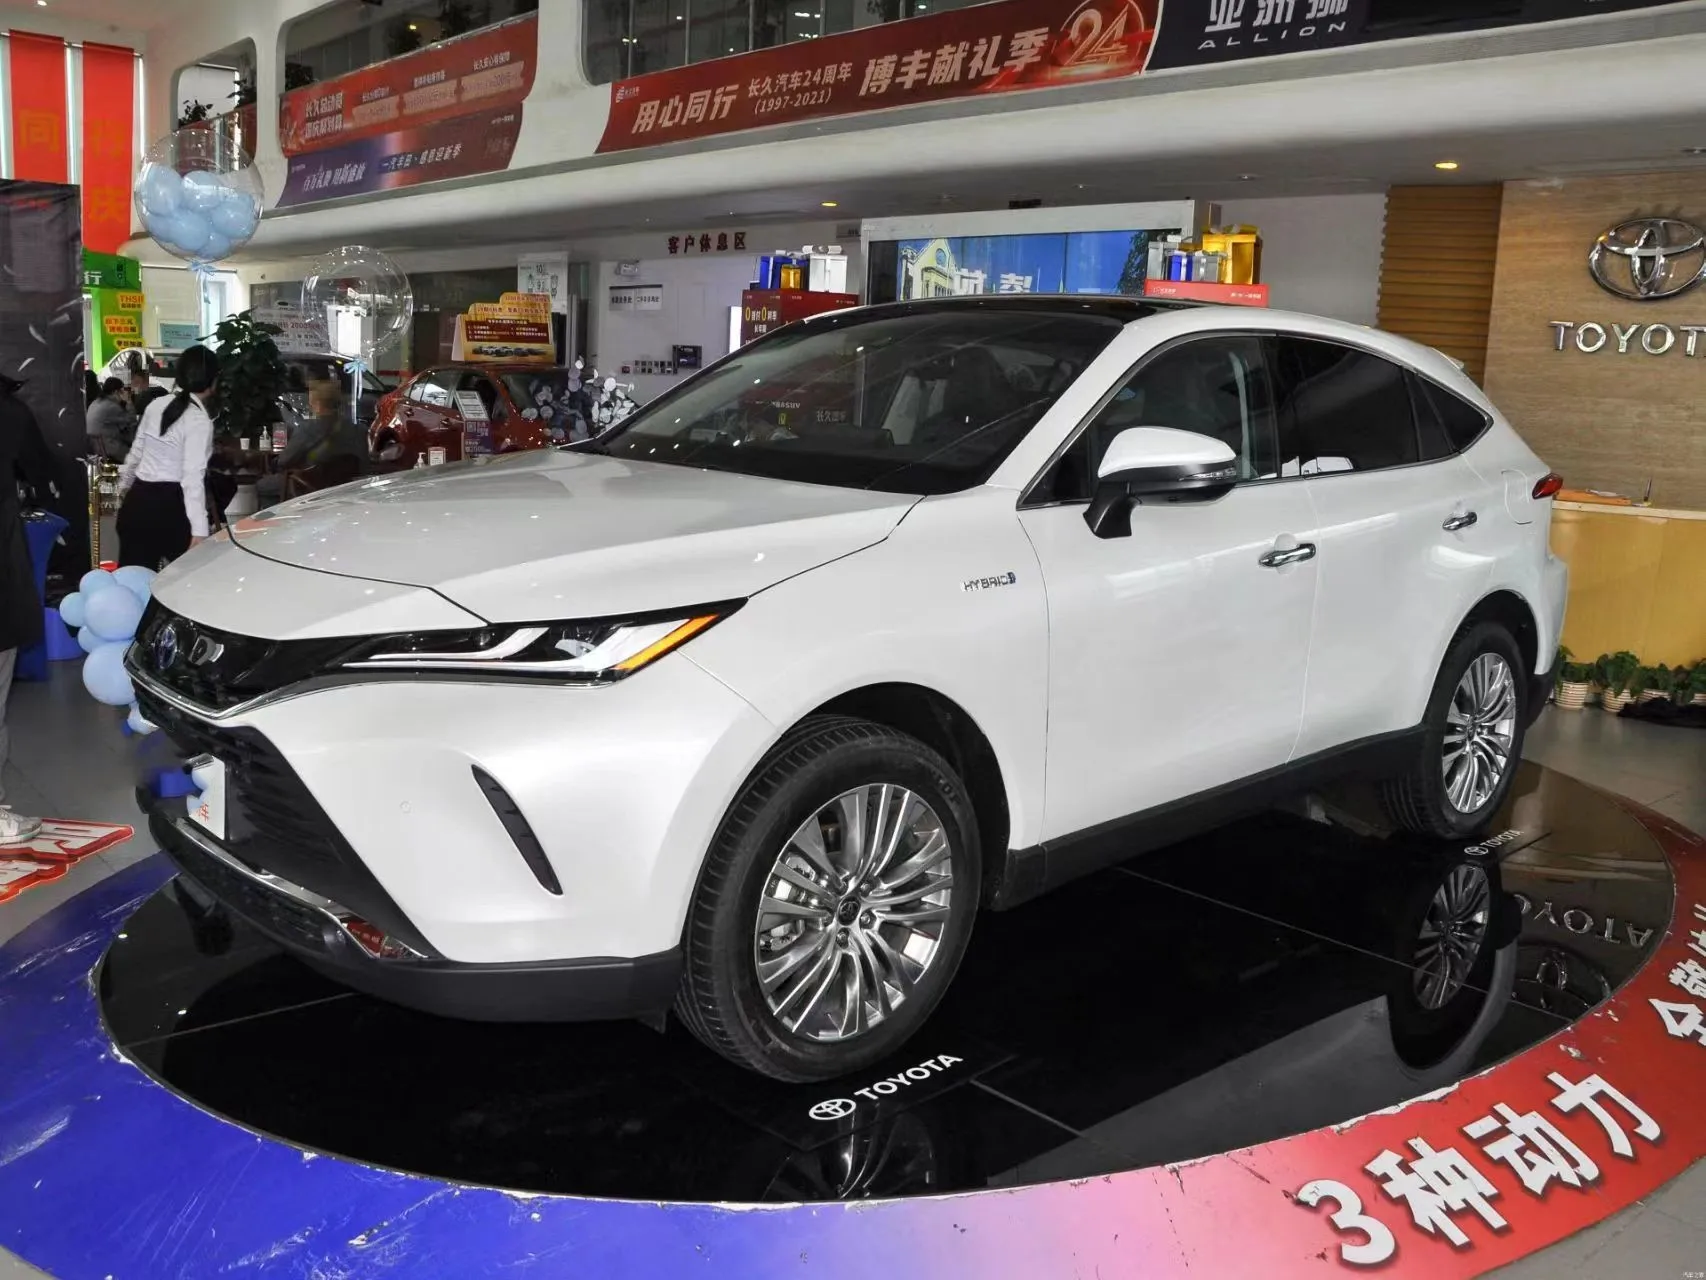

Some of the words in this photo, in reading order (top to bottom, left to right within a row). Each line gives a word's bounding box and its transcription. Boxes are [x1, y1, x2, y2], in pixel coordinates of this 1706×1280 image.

[1197, 21, 1346, 50] ALLION
[748, 61, 853, 98] 长久汽车24周年
[858, 26, 1049, 96] 博丰献礼季
[631, 83, 740, 135] 用心同行
[753, 88, 832, 115] (1997-2021)
[668, 231, 747, 254] 客户休息区
[1549, 320, 1706, 357] TOYOT
[962, 574, 1008, 592] HYBRID
[854, 1054, 963, 1100] TOYOTA
[1297, 1071, 1662, 1265] 3种动力
